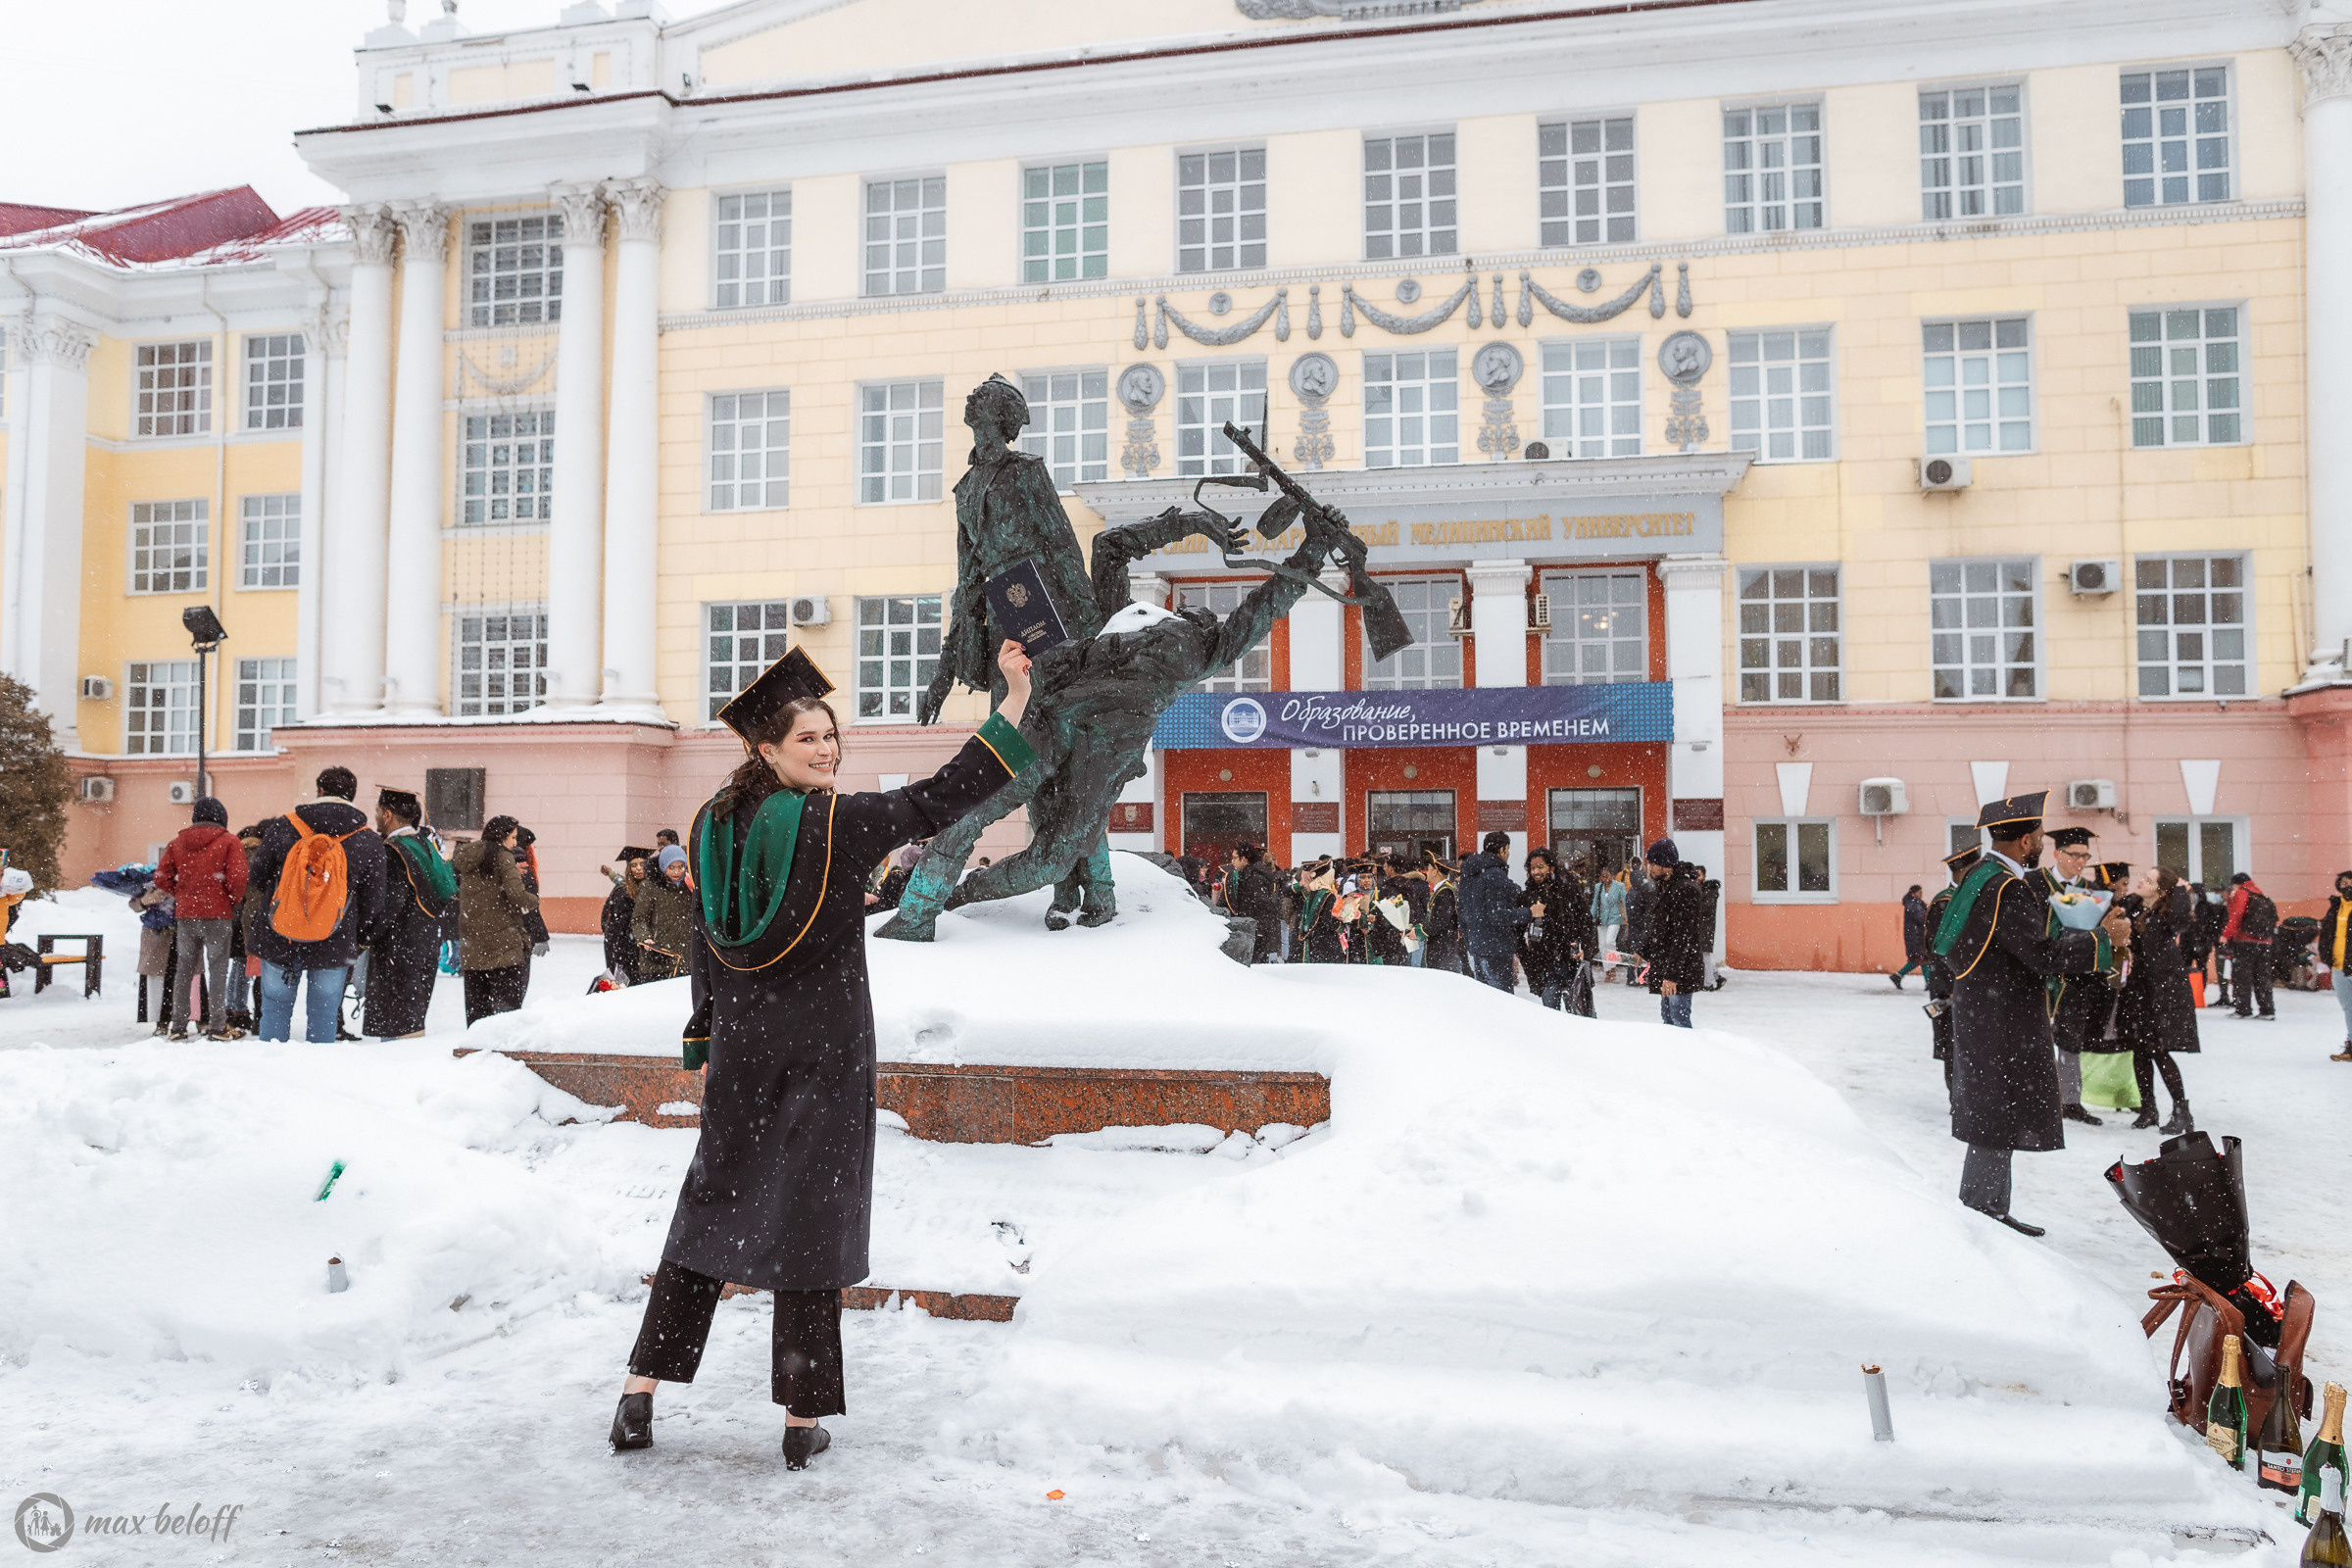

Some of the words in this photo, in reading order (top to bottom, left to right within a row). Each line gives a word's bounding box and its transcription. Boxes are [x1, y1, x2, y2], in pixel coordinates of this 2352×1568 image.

[1410, 514, 1552, 548] МЕДИЦИНСКИЙ
[1561, 513, 1696, 539] УНИВЕРСИТЕТ
[1020, 619, 1047, 638] ДИПЛОМ
[1281, 696, 1416, 733] Образование,
[1343, 721, 1491, 742] ПРОВЕРЕННОЕ
[1497, 717, 1610, 739] ВРЕМЕНЕМ
[2267, 1462, 2285, 1472] SANTO
